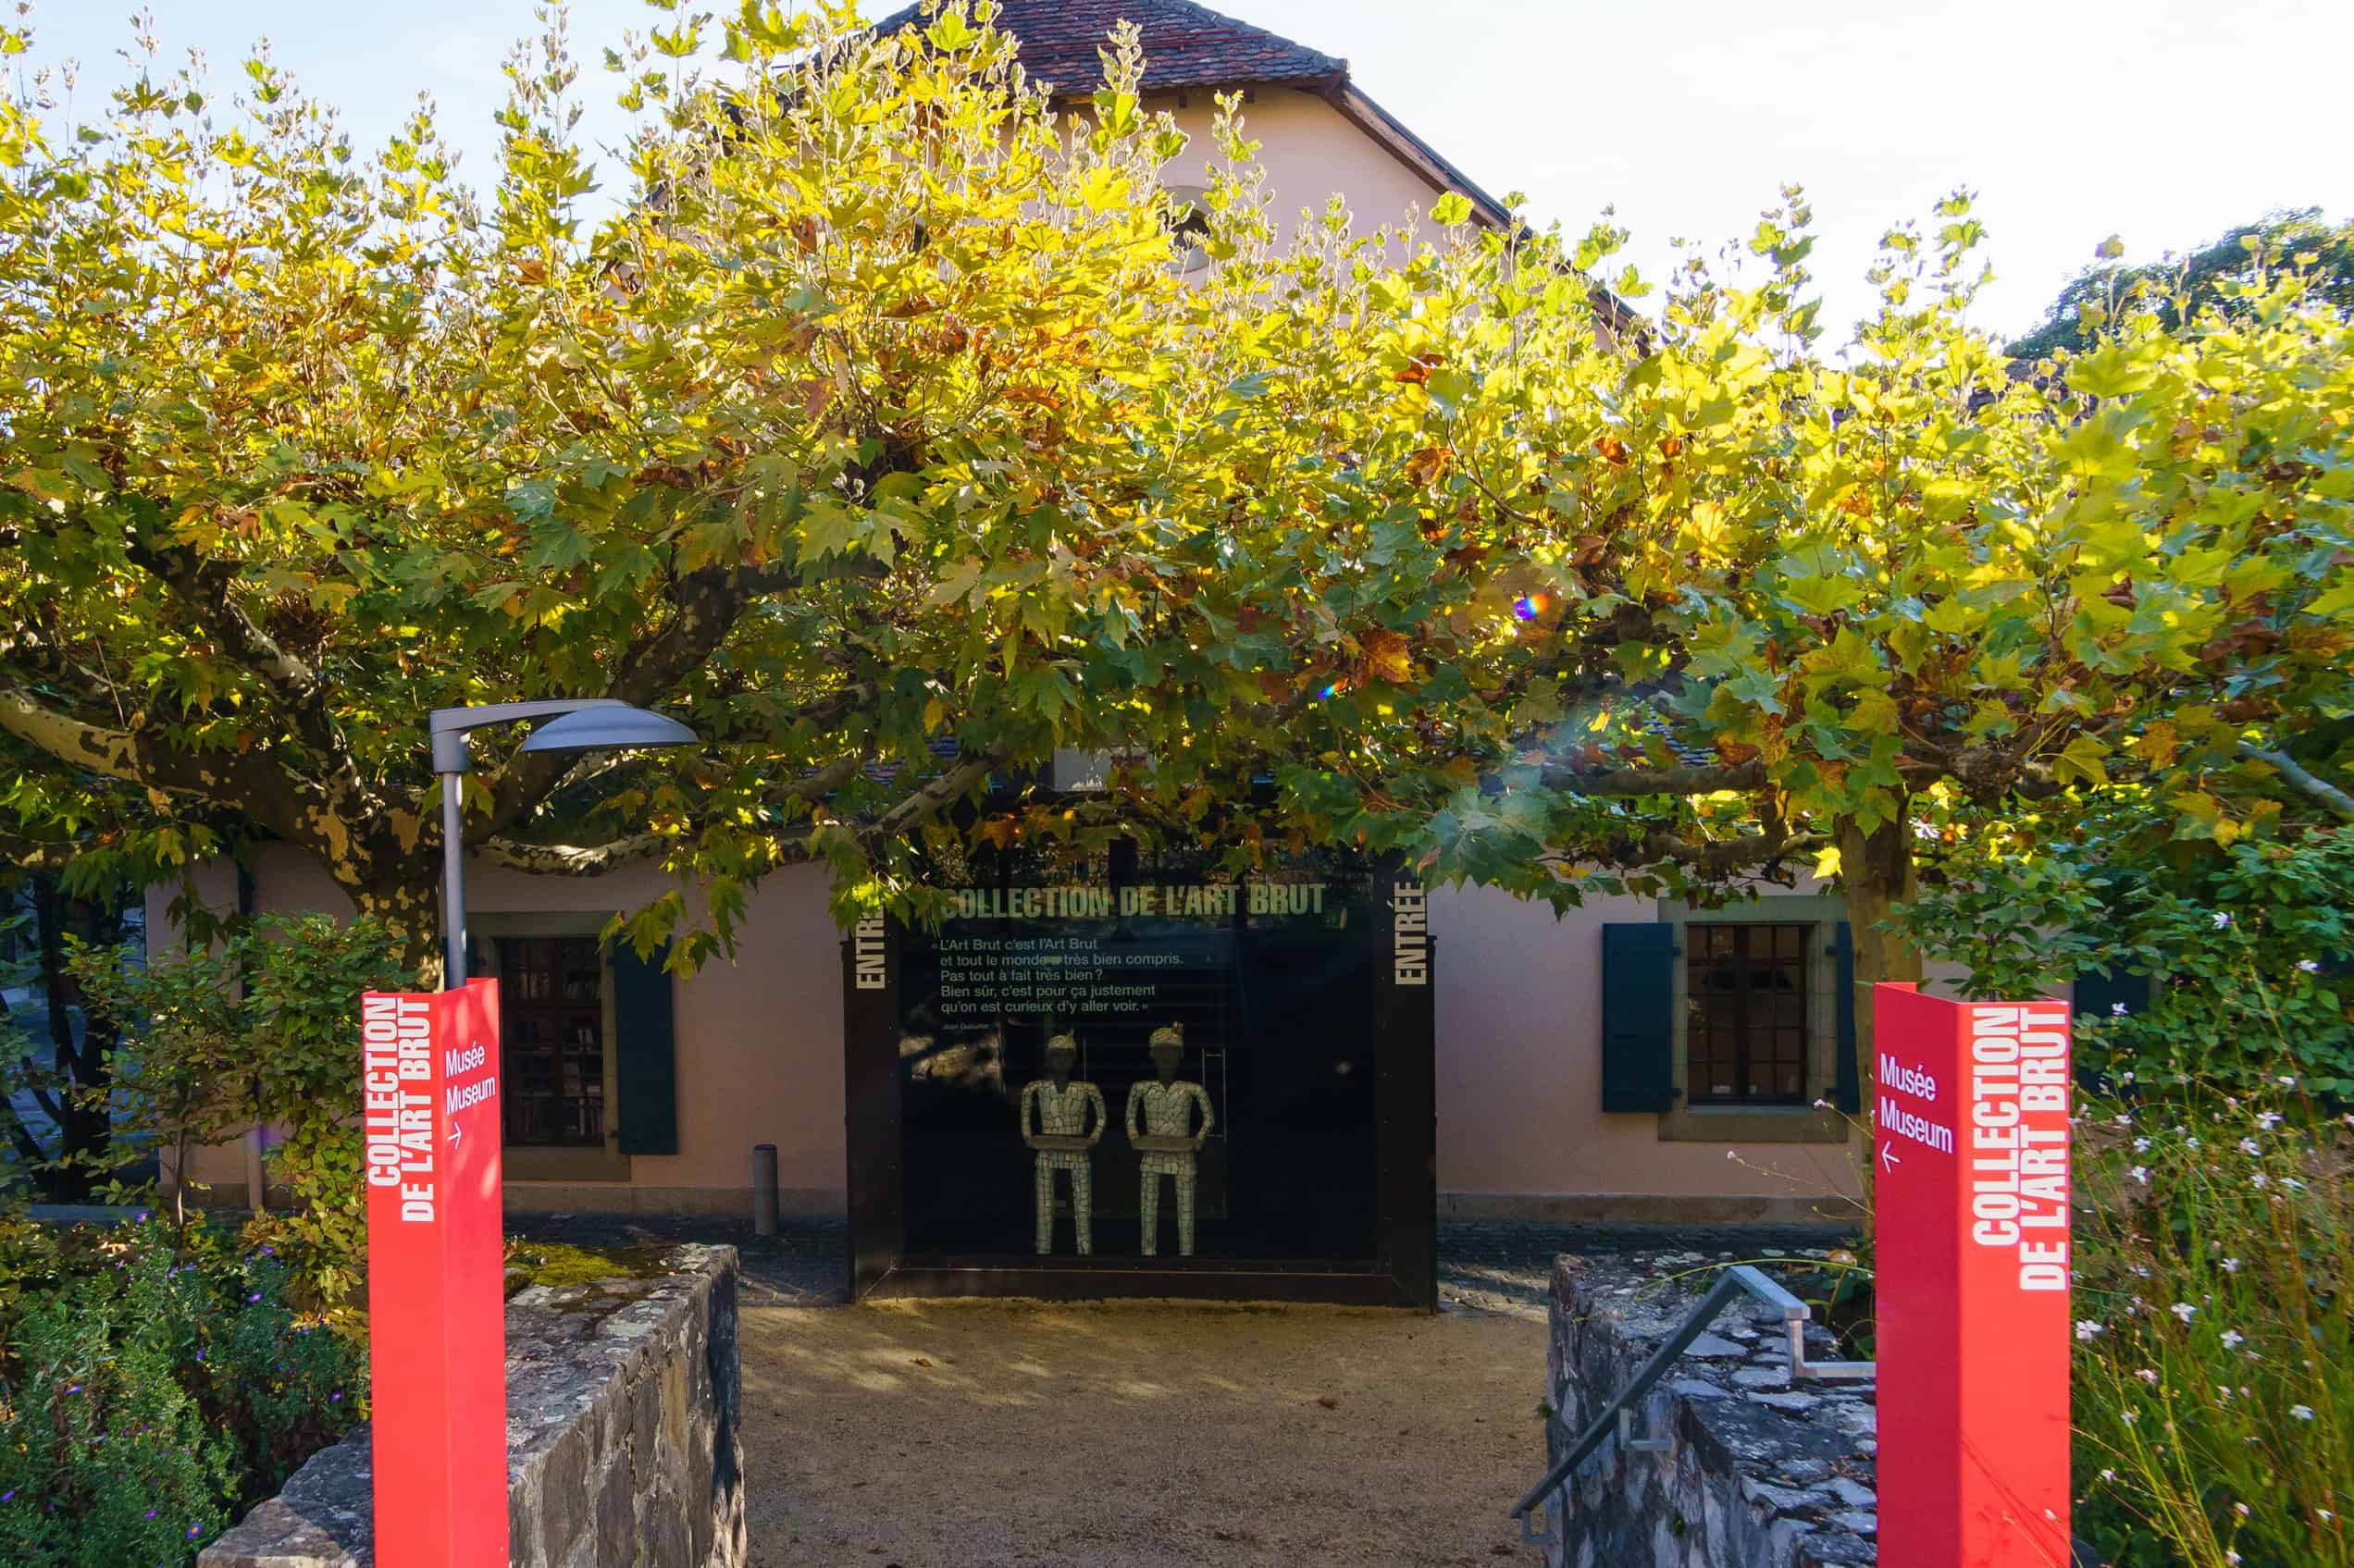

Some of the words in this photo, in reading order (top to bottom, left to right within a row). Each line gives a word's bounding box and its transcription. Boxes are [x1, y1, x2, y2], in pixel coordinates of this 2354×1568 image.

[941, 887, 1109, 918] COLLECTION
[1120, 885, 1156, 917] DE
[1165, 884, 1241, 916] L'ART
[1249, 883, 1326, 915] BRUT
[855, 904, 886, 990] ENTR
[973, 938, 1000, 951] Brut
[1005, 938, 1035, 951] c'est
[1039, 937, 1065, 950] l'Art
[1070, 937, 1097, 950] Brut
[1387, 882, 1427, 985] ENTRÉE
[940, 956, 952, 967] et
[957, 955, 983, 967] tout
[986, 954, 997, 966] le
[1002, 954, 1044, 966] monde
[1064, 953, 1089, 966] très
[1094, 953, 1121, 965] bien
[1125, 953, 1183, 968] compris.
[941, 970, 965, 982] Pas
[970, 969, 995, 982] tout
[998, 969, 1008, 982] à
[1011, 969, 1032, 981] fait
[1036, 969, 1060, 981] très
[941, 985, 971, 998] Bien
[973, 985, 997, 1000] sûr,
[1001, 984, 1032, 997] c'est
[1036, 987, 1066, 1001] pour
[1071, 986, 1086, 1000] ça
[1090, 984, 1155, 1000] justement
[941, 1002, 977, 1015] qu'on
[981, 1002, 1000, 1013] est
[1005, 1001, 1053, 1013] curieux
[1057, 1000, 1077, 1015] d'y
[1081, 1000, 1109, 1012] aller
[397, 997, 431, 1080] BRUT
[445, 1041, 486, 1078] Musée
[2020, 1006, 2066, 1111] BRUT
[365, 996, 401, 1187] COLLECTION
[446, 1076, 496, 1115] Museum
[1880, 1053, 1937, 1101] Musée
[400, 1091, 433, 1172] L'ART
[1880, 1095, 1954, 1154] Museum
[1972, 1006, 2020, 1246] COLLECTION
[2020, 1125, 2066, 1227] L'ART
[402, 1183, 435, 1222] DE
[2020, 1241, 2066, 1290] DE
